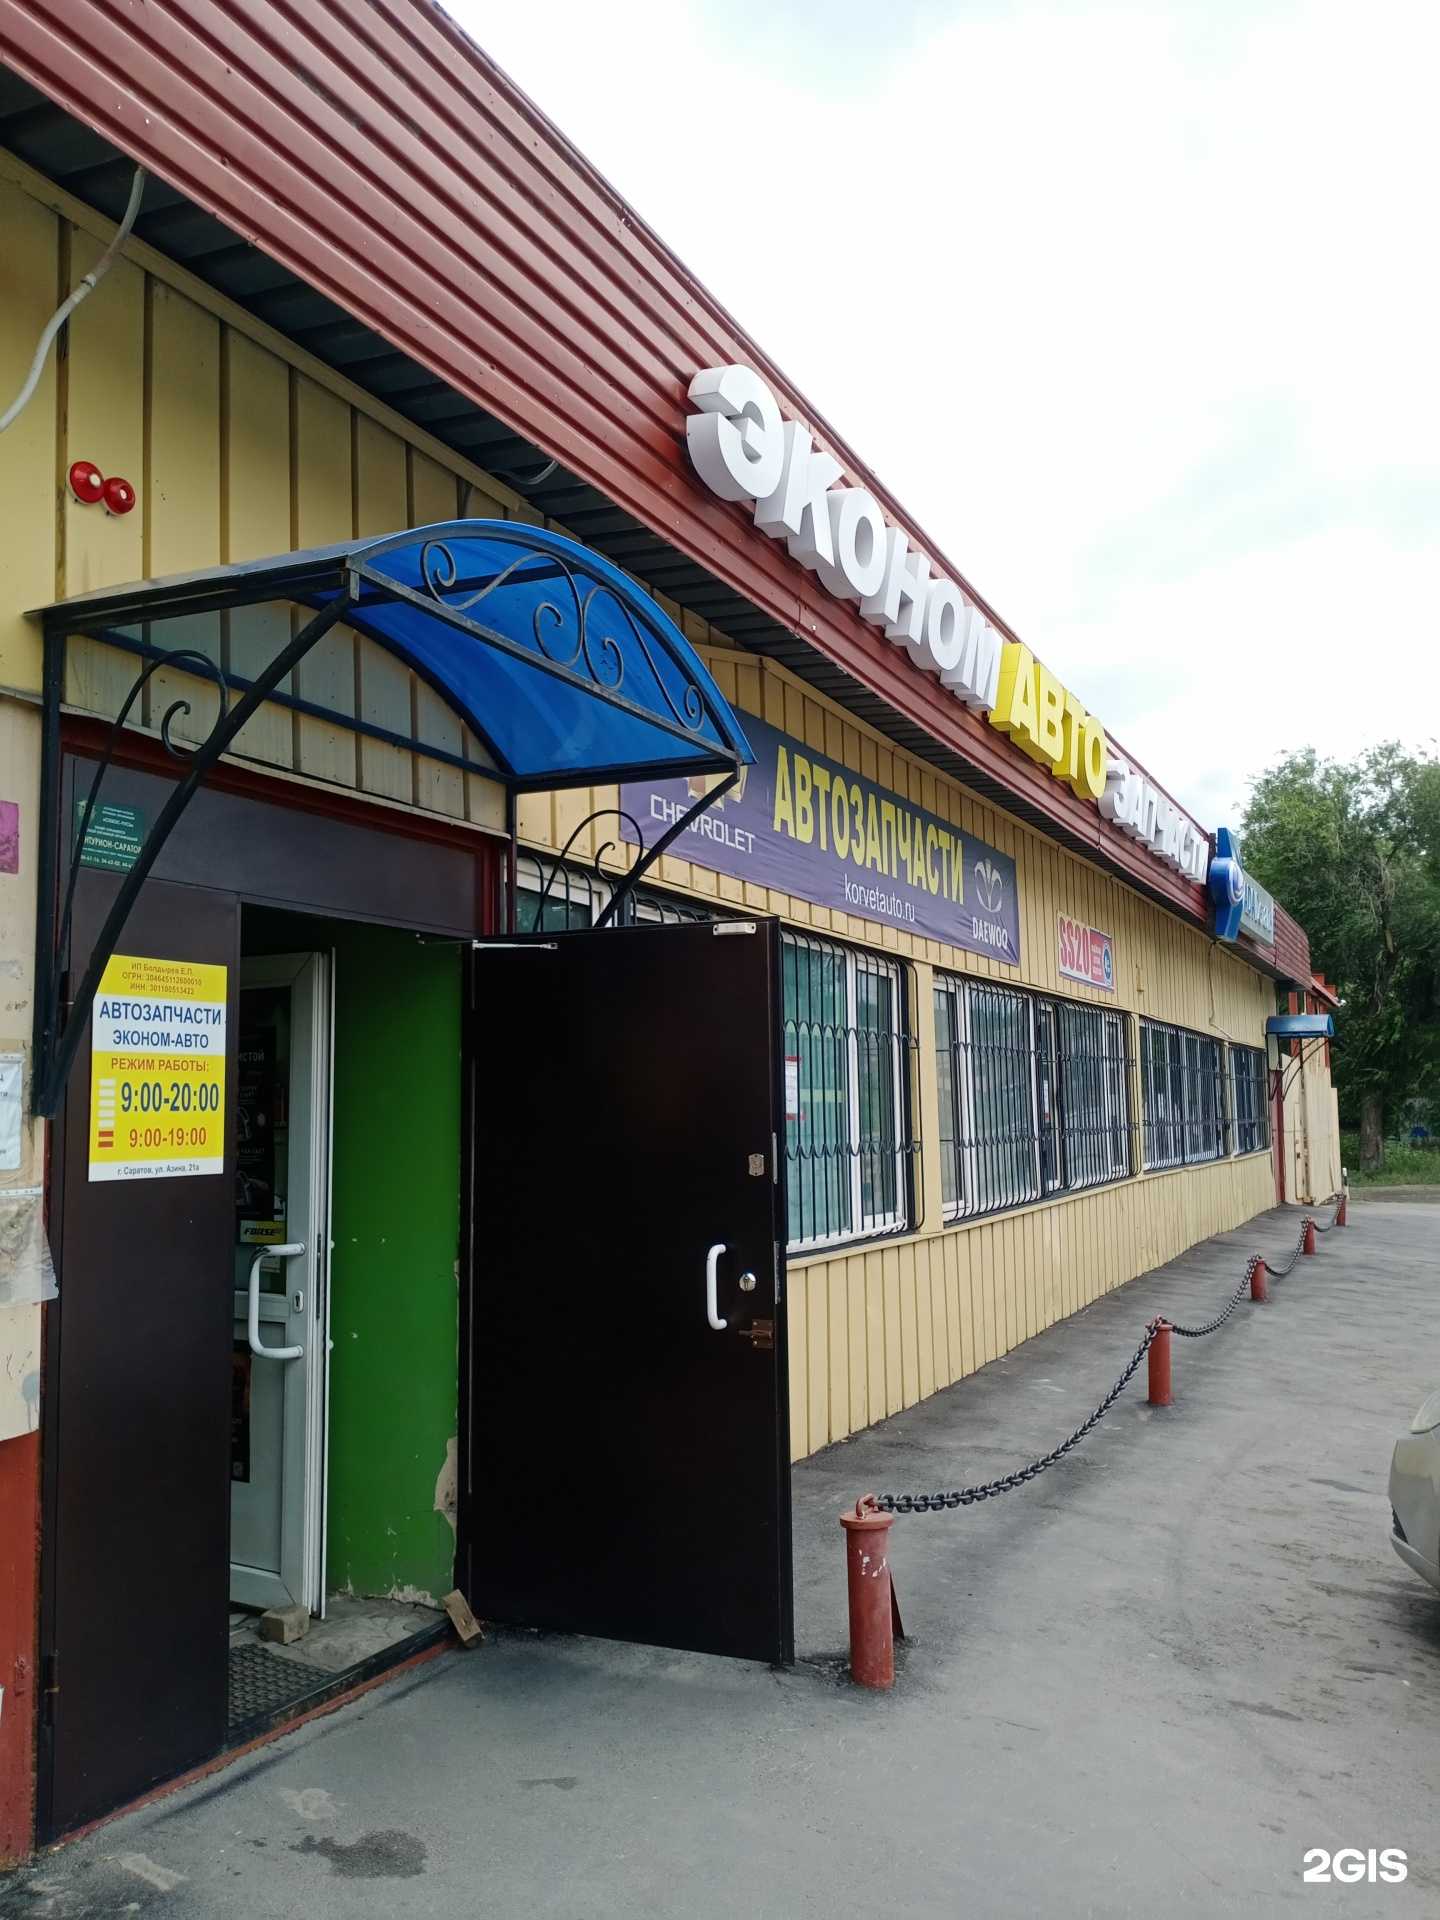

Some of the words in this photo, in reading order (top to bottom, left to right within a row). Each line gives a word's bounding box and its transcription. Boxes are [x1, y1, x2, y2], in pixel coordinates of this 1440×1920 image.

[686, 363, 1004, 713] ЭКОНОМ
[989, 643, 1107, 800] АВТО
[1098, 760, 1210, 886] ЗАПЧАСТИ
[650, 794, 756, 854] CHEVROLET
[773, 744, 965, 905] АВТОЗАПЧАСТИ
[844, 873, 915, 922] korvetauto.ru
[972, 916, 1009, 950] DAEWOO
[1059, 916, 1090, 975] SS20
[131, 963, 142, 971] ИП
[99, 1001, 222, 1025] АВТОЗАПЧАСТИ
[112, 1029, 209, 1049] ЭКОНОМ-АВТО
[111, 1057, 155, 1071] РЕЖИМ
[158, 1059, 209, 1072] РАБОТЫ:
[121, 1081, 219, 1112] 9:00-20:00
[129, 1126, 207, 1148] 9:00-19:00
